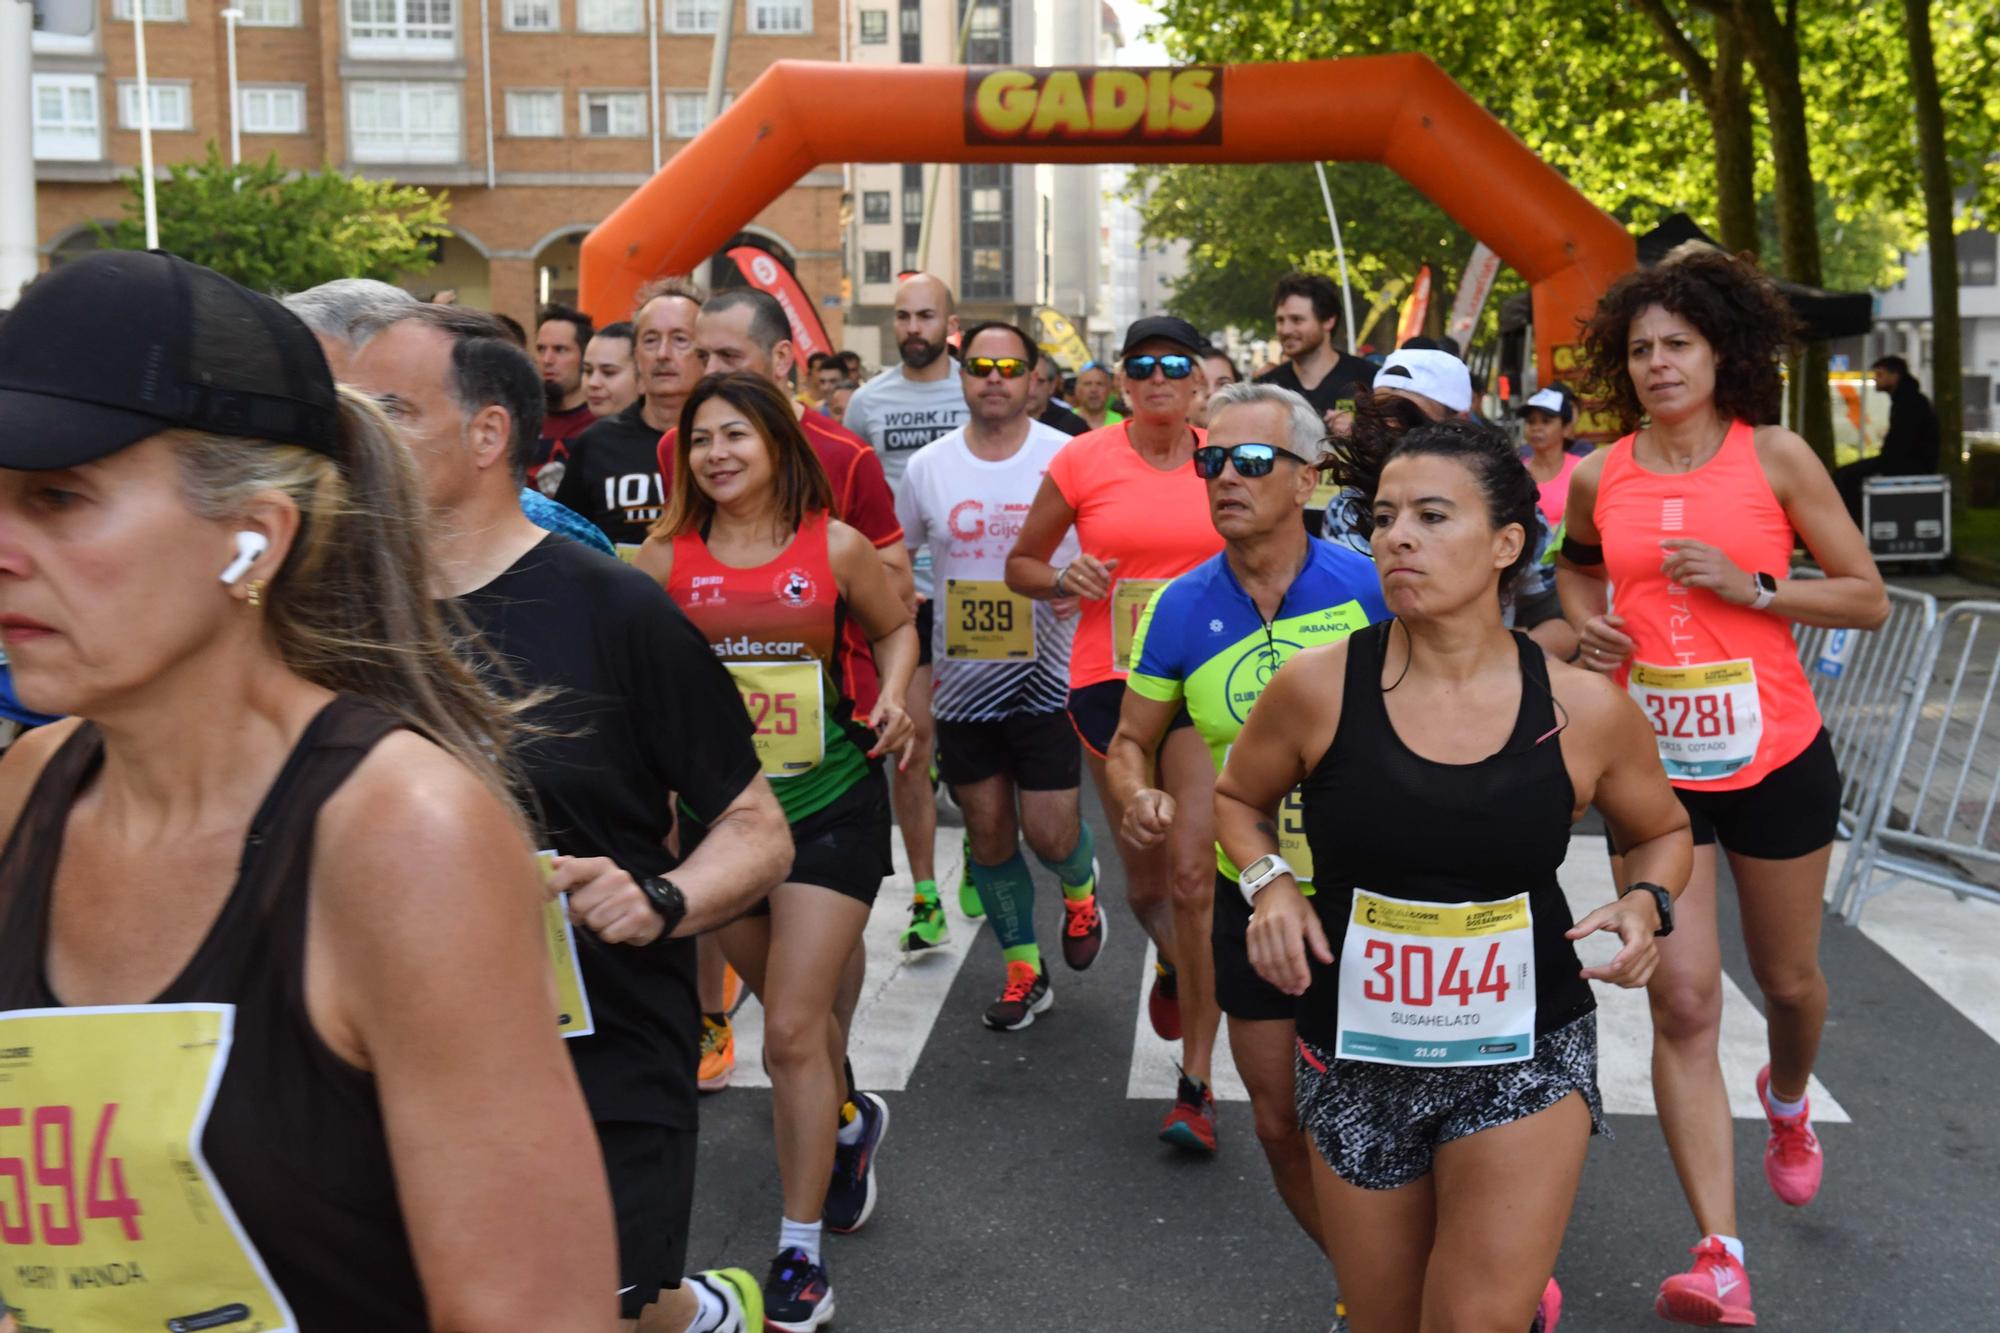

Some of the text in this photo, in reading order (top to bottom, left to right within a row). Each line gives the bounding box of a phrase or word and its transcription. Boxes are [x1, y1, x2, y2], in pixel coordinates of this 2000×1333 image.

[975, 69, 1216, 137] GADIS
[884, 410, 959, 426] WORK IT
[887, 430, 932, 448] OWN
[962, 600, 1013, 632] 339
[1300, 622, 1350, 633] ABANCA
[1233, 691, 1255, 702] CLUB
[737, 692, 798, 735] 25
[1645, 692, 1735, 738] 3281
[1363, 939, 1511, 1007] 3044
[1390, 1011, 1481, 1027] SUSAHELATO
[1413, 1047, 1448, 1058] 21.05
[0, 1102, 143, 1245] 594
